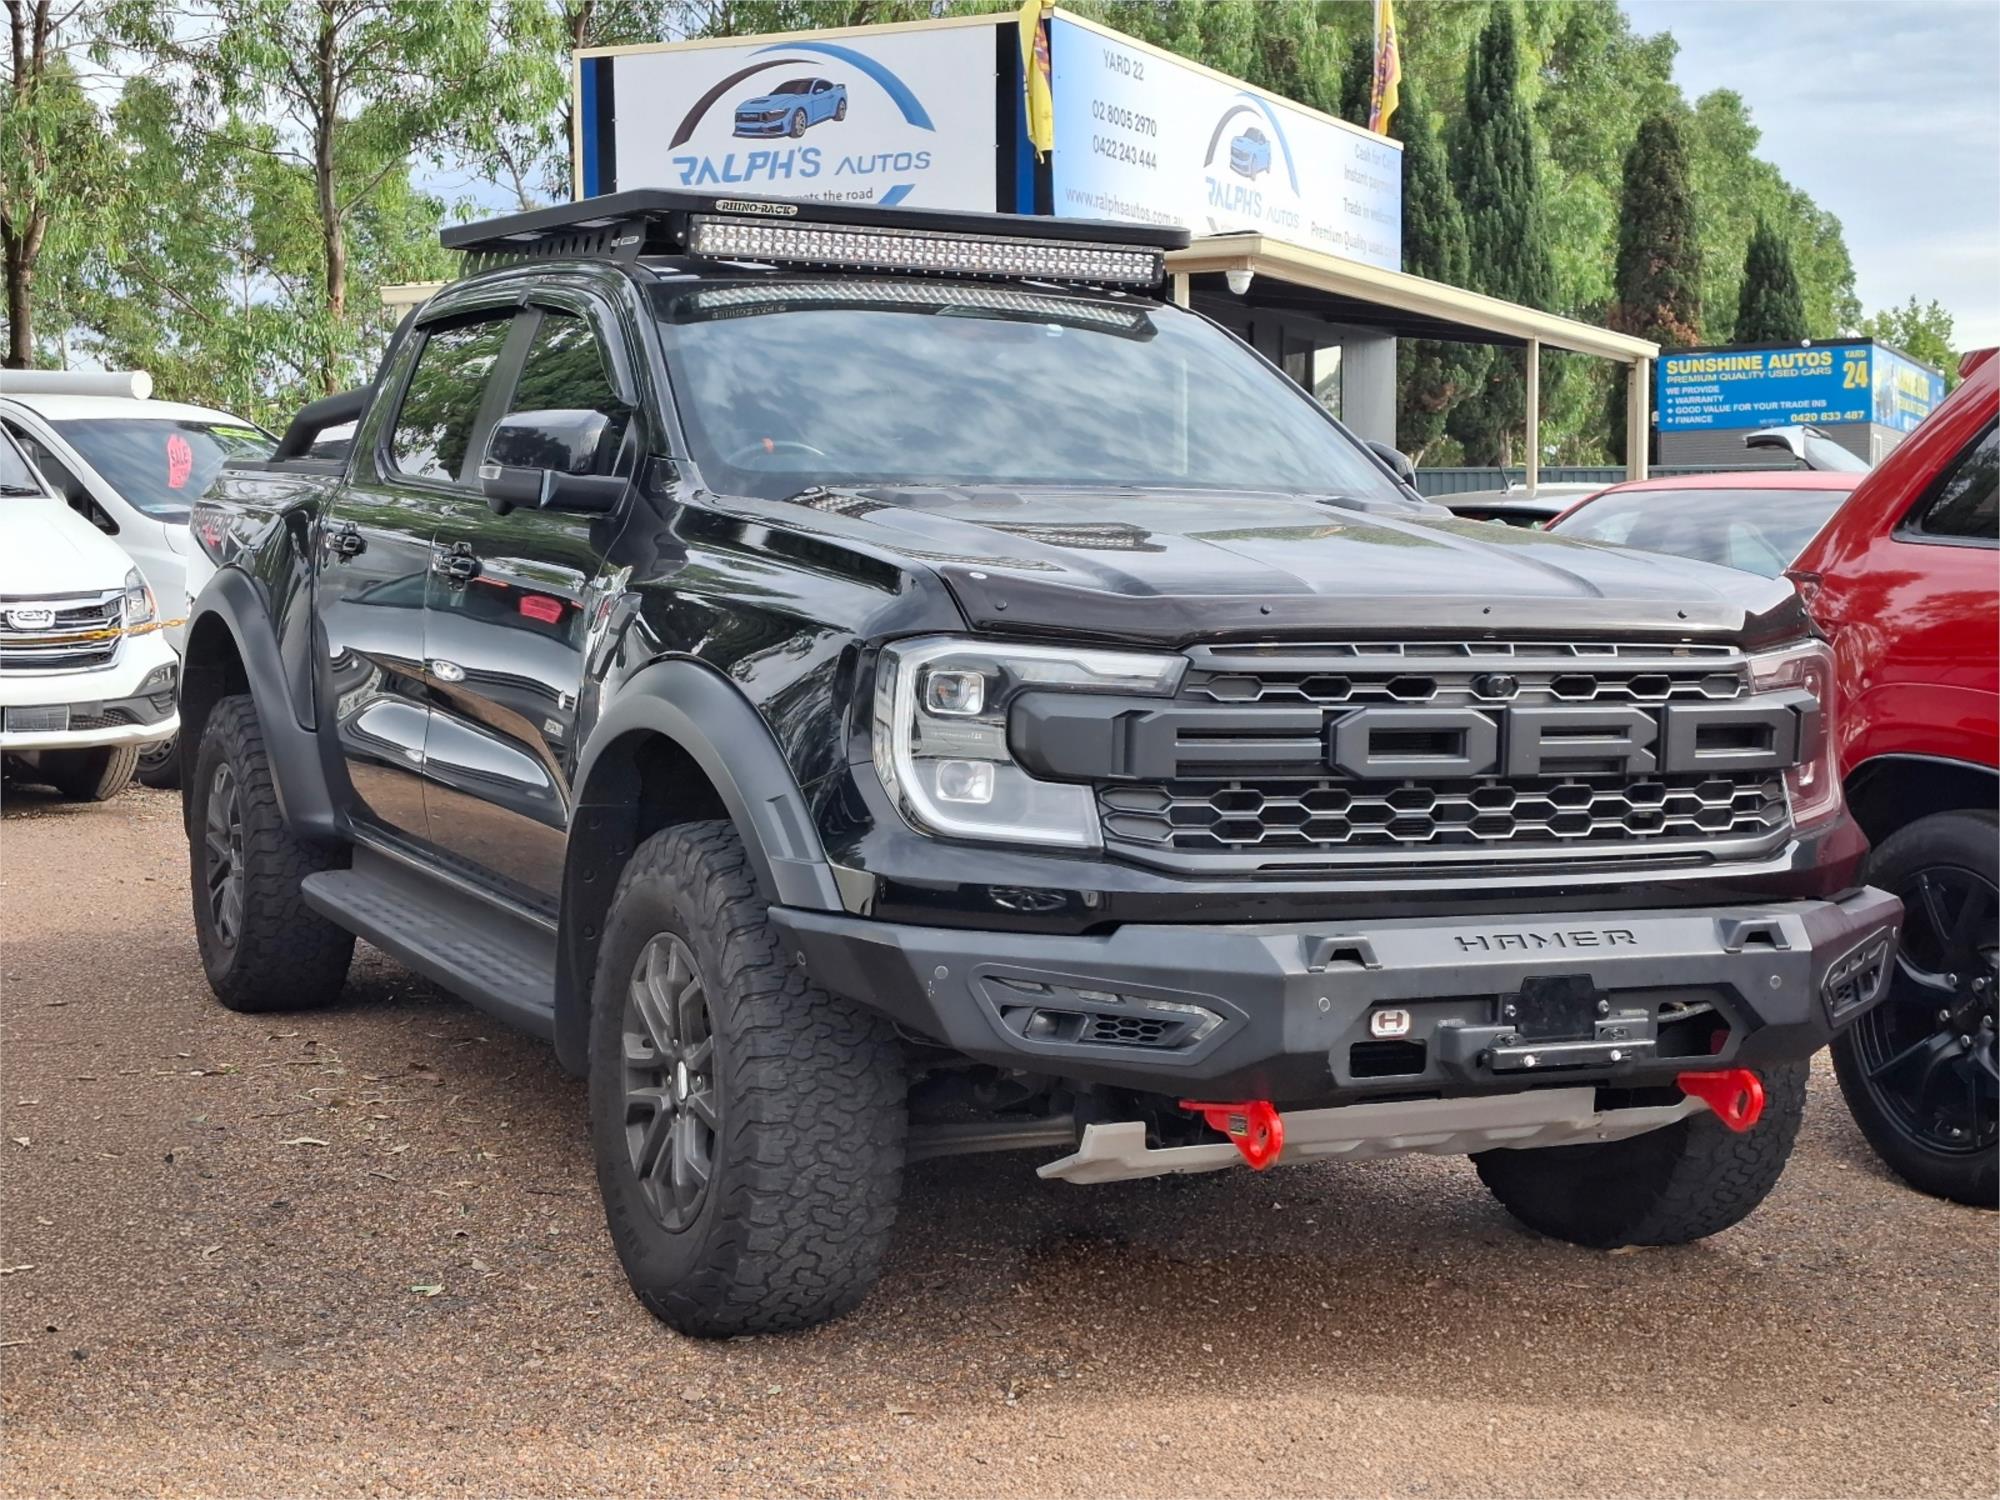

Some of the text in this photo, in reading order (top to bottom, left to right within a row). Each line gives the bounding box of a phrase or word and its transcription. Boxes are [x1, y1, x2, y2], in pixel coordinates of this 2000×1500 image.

[1103, 48, 1145, 82] YARD 22
[1092, 99, 1158, 138] 02 8005 2970
[1093, 134, 1157, 171] 0422 243 444
[672, 147, 931, 187] RALPH'S AUTOS
[824, 189, 843, 201] the
[846, 187, 873, 200] road
[721, 201, 793, 216] RHINO-RACK
[1266, 206, 1300, 229] AUTOS
[1666, 351, 1832, 375] SUNSHINE AUTOS
[1666, 366, 1832, 384] PREMIUM QUALITY USED CARS
[1842, 361, 1868, 390] 24
[1665, 385, 1720, 396] WE PROVIDE
[1675, 395, 1724, 405] WARRANTY
[1675, 406, 1702, 414] GOOD
[1703, 404, 1731, 413] VALUE
[1733, 403, 1751, 412] FOR
[1753, 401, 1778, 411] YOUR
[1780, 400, 1810, 409] TRADE
[1675, 415, 1714, 424] FINANCE
[1128, 692, 1802, 781] FORD
[1453, 927, 1639, 954] HAMER
